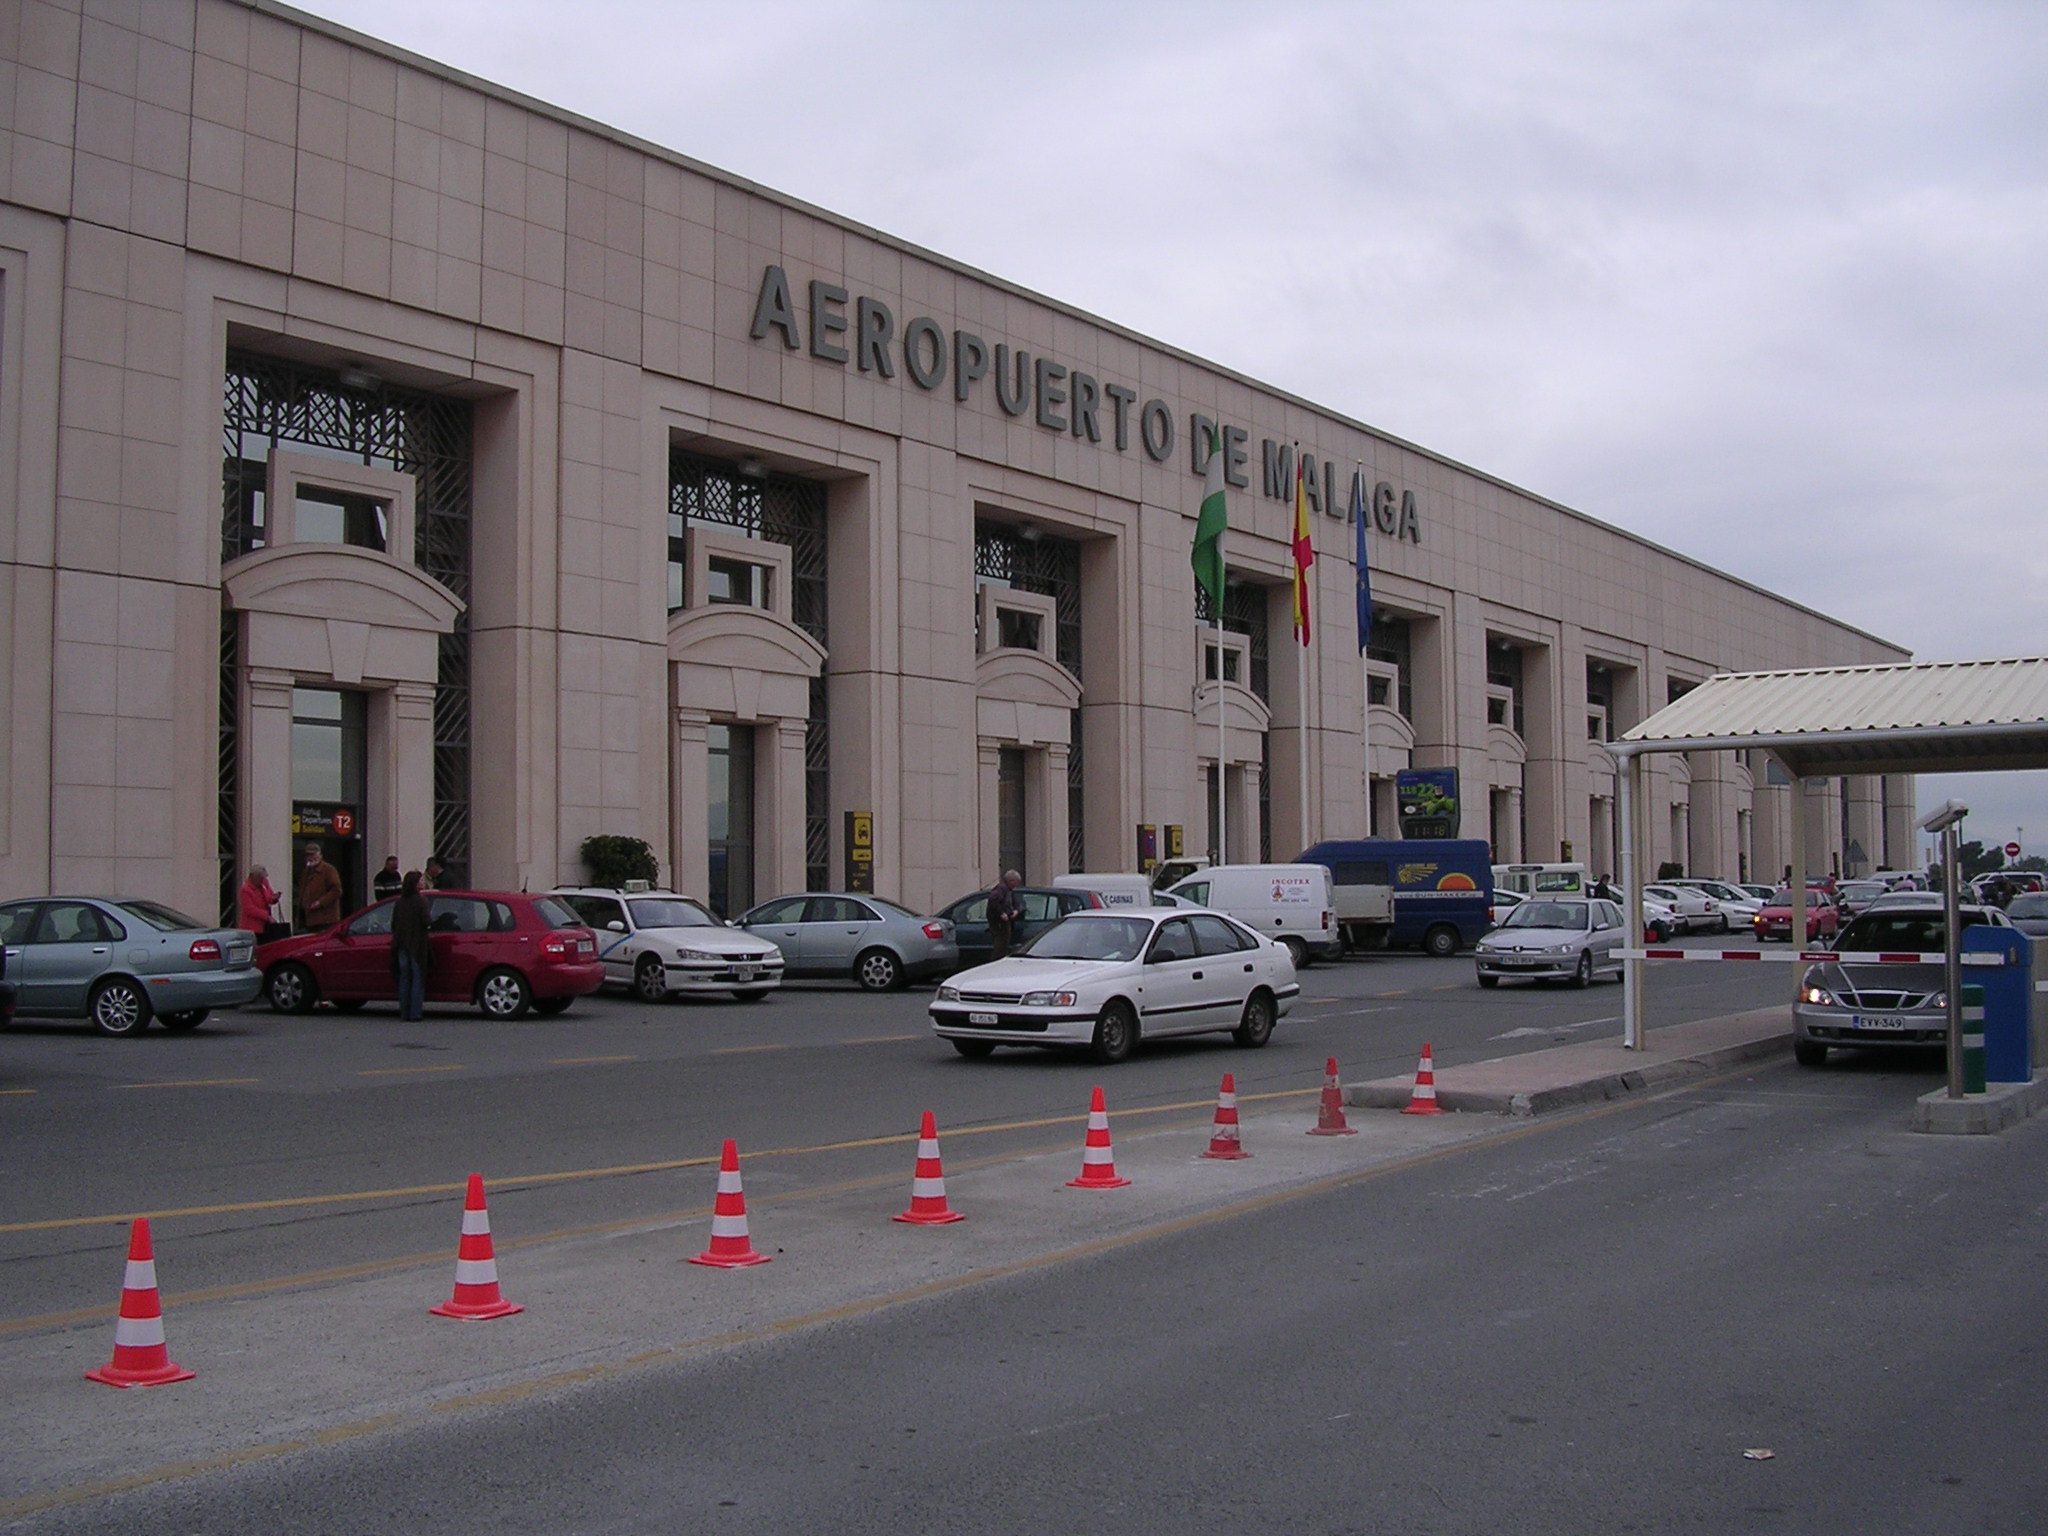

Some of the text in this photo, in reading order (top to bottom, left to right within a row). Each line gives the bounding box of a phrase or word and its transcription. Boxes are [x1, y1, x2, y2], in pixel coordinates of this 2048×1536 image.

[750, 264, 1420, 544] AEROPUERTO DE MALAGA
[336, 815, 351, 829] T2
[1109, 895, 1133, 904] CABINAS
